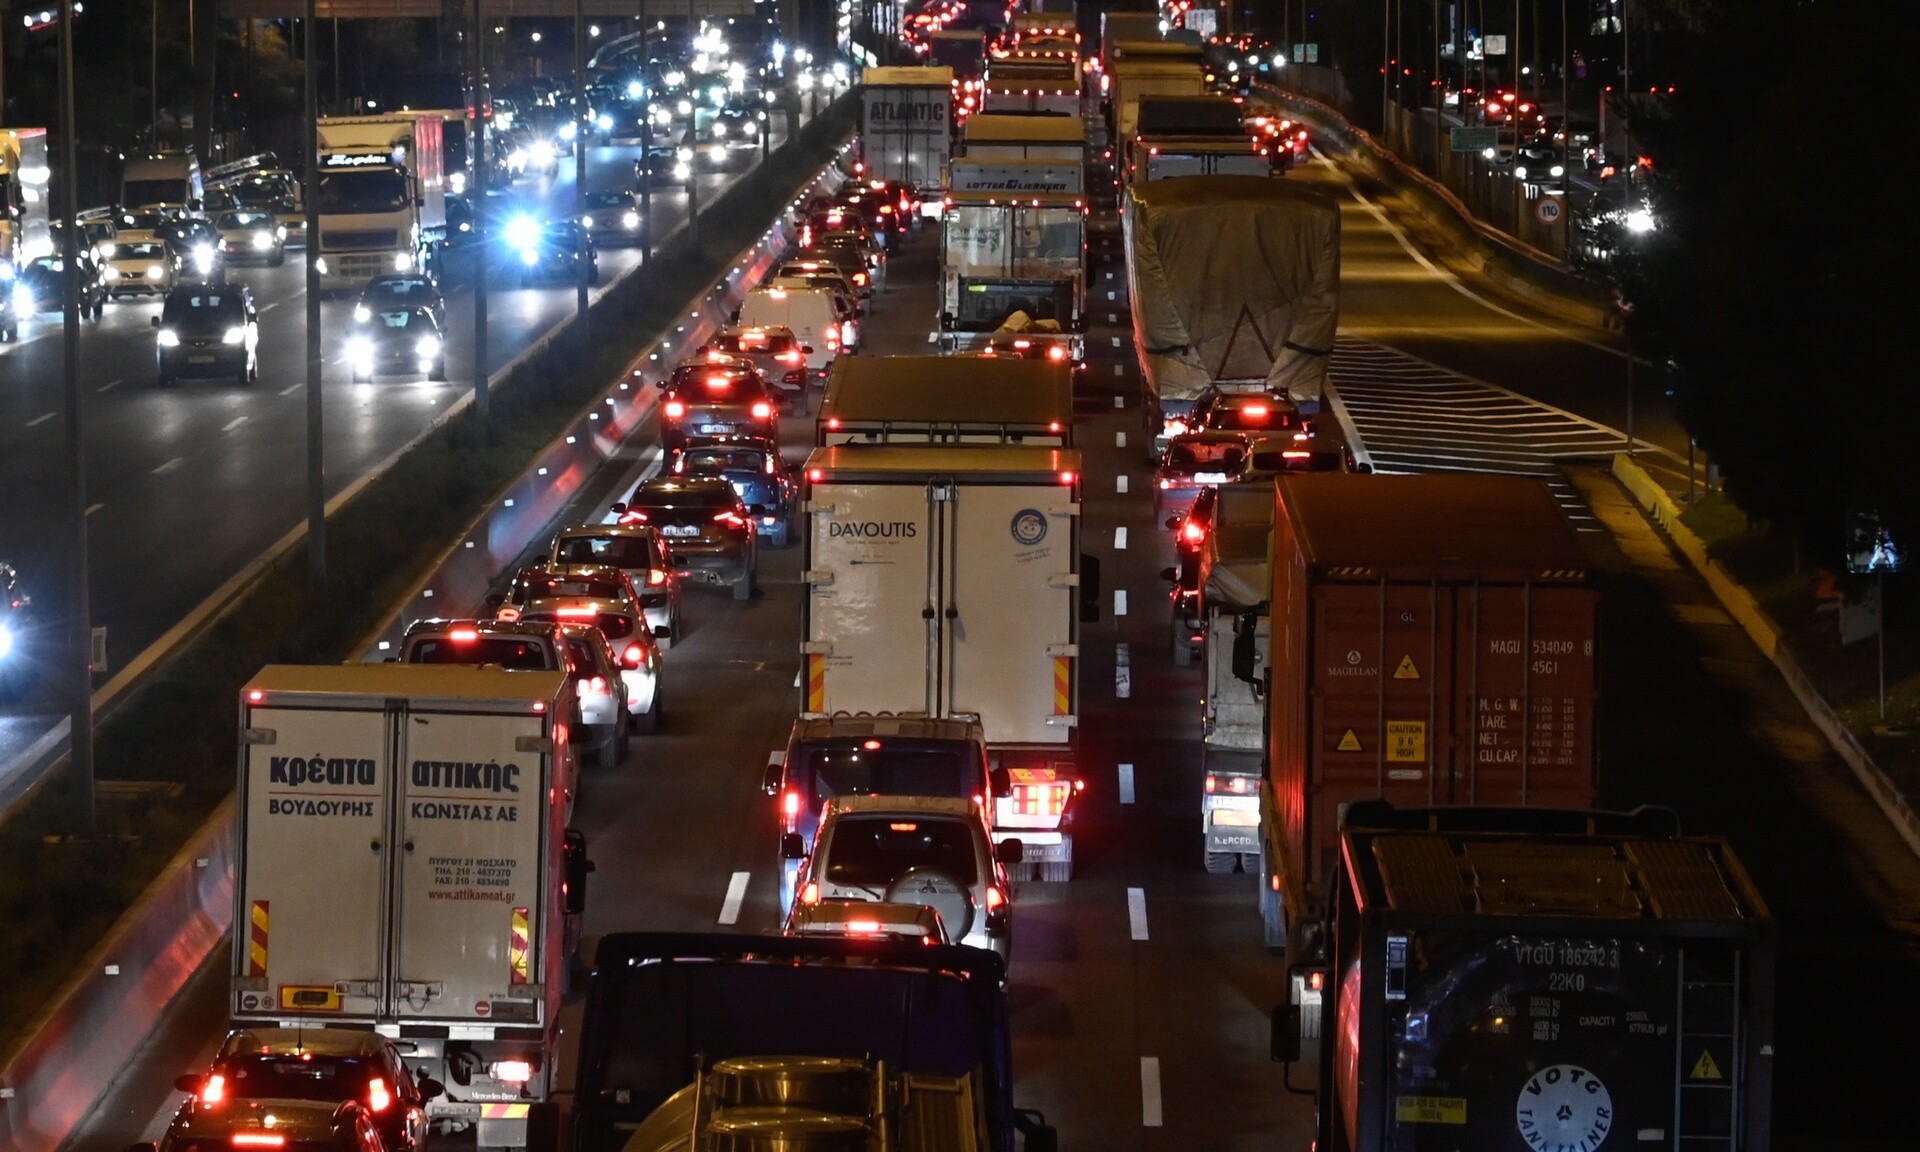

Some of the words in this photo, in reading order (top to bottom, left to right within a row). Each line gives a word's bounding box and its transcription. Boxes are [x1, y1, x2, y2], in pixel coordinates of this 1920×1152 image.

[870, 102, 944, 121] ATLANTIC
[967, 181, 1005, 189] LOTTER
[1542, 205, 1558, 216] 110
[829, 522, 917, 538] DAVOUTIS
[1401, 612, 1415, 622] GL
[1490, 639, 1521, 654] MAGU
[1532, 640, 1574, 655] 534049
[1328, 667, 1378, 676] MAGELLAN
[1480, 715, 1507, 729] TARE
[1389, 724, 1422, 734] CAUTION
[1479, 732, 1498, 745] NET
[1396, 748, 1415, 758] HIGH
[411, 758, 520, 793] αττικής
[269, 798, 374, 817] ΒΟΥΔΟΥΡΗΣ
[411, 802, 493, 821] ΚΩΝΣΤΑΣ
[496, 805, 518, 822] ΑΕ
[476, 858, 517, 867] ΜΟΣΧΑΤΟ
[455, 867, 470, 876] 210
[455, 877, 470, 885] 210
[428, 889, 516, 904] www.attikameat.gr
[1515, 945, 1555, 966] VTGU
[1558, 947, 1605, 967] 186242
[1579, 1015, 1616, 1027] CAPACITY
[1526, 1067, 1601, 1096] VOTG
